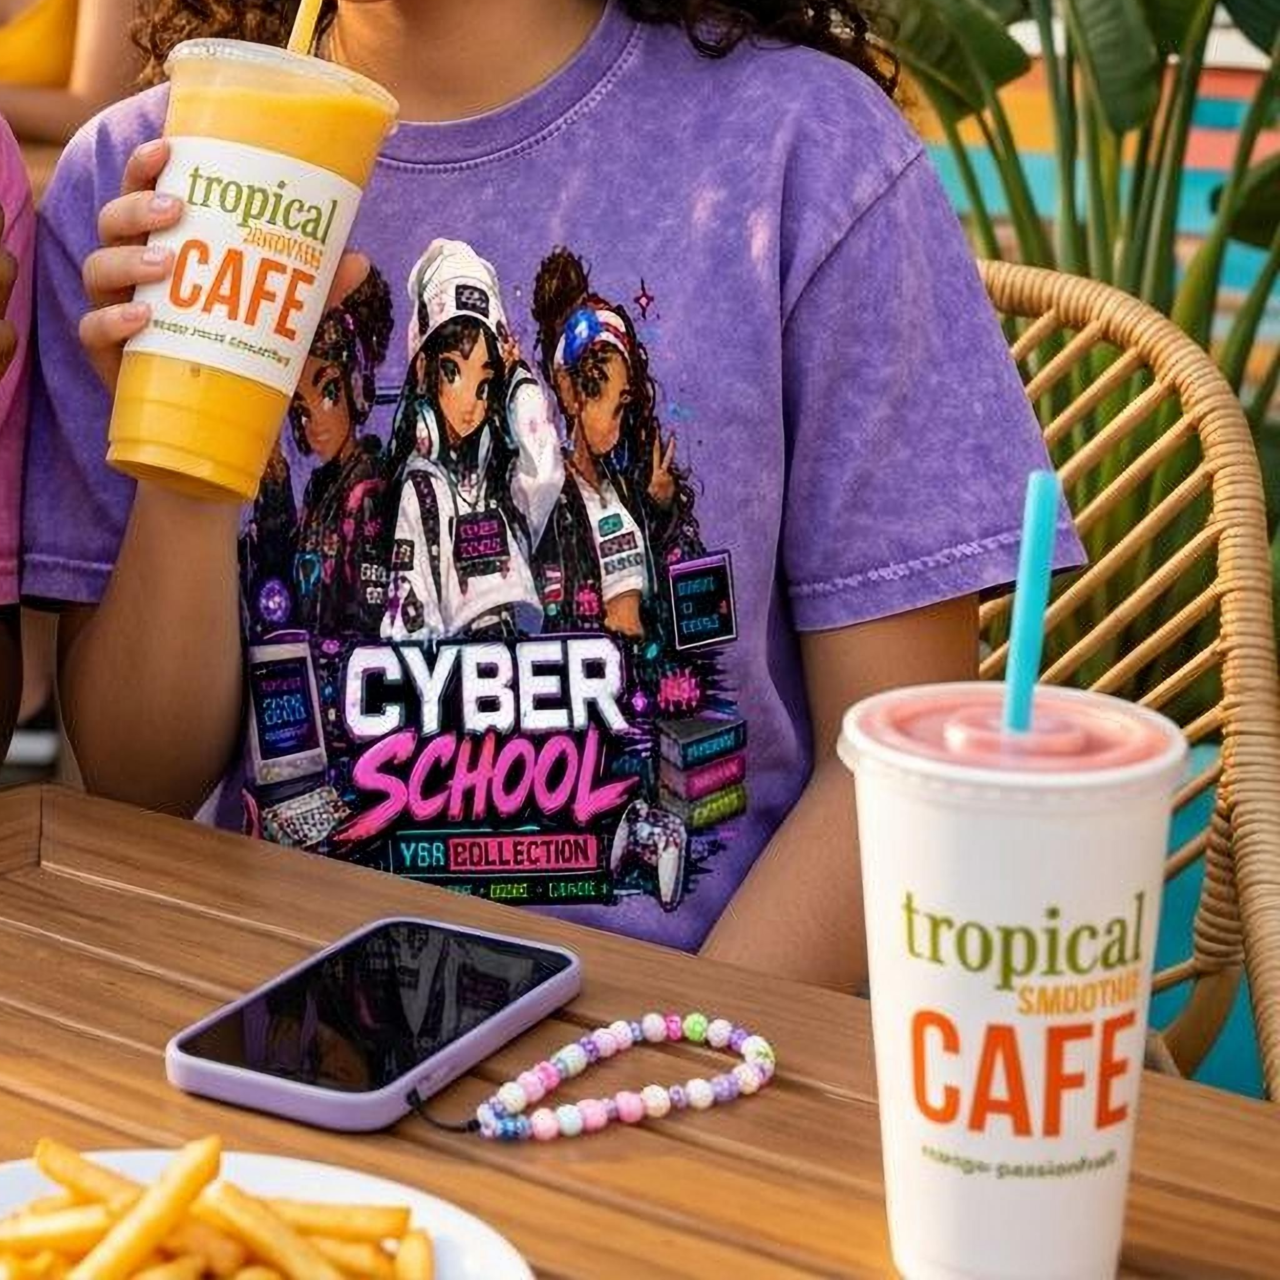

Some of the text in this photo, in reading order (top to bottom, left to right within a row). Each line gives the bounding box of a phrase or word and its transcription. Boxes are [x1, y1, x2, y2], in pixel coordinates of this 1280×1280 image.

[187, 167, 338, 245] tropical
[169, 239, 316, 341] CAFE
[344, 637, 630, 741] CYBER
[332, 727, 639, 844] SCHOOL
[903, 891, 1145, 991] tropical
[909, 1009, 1138, 1138] CAFE
